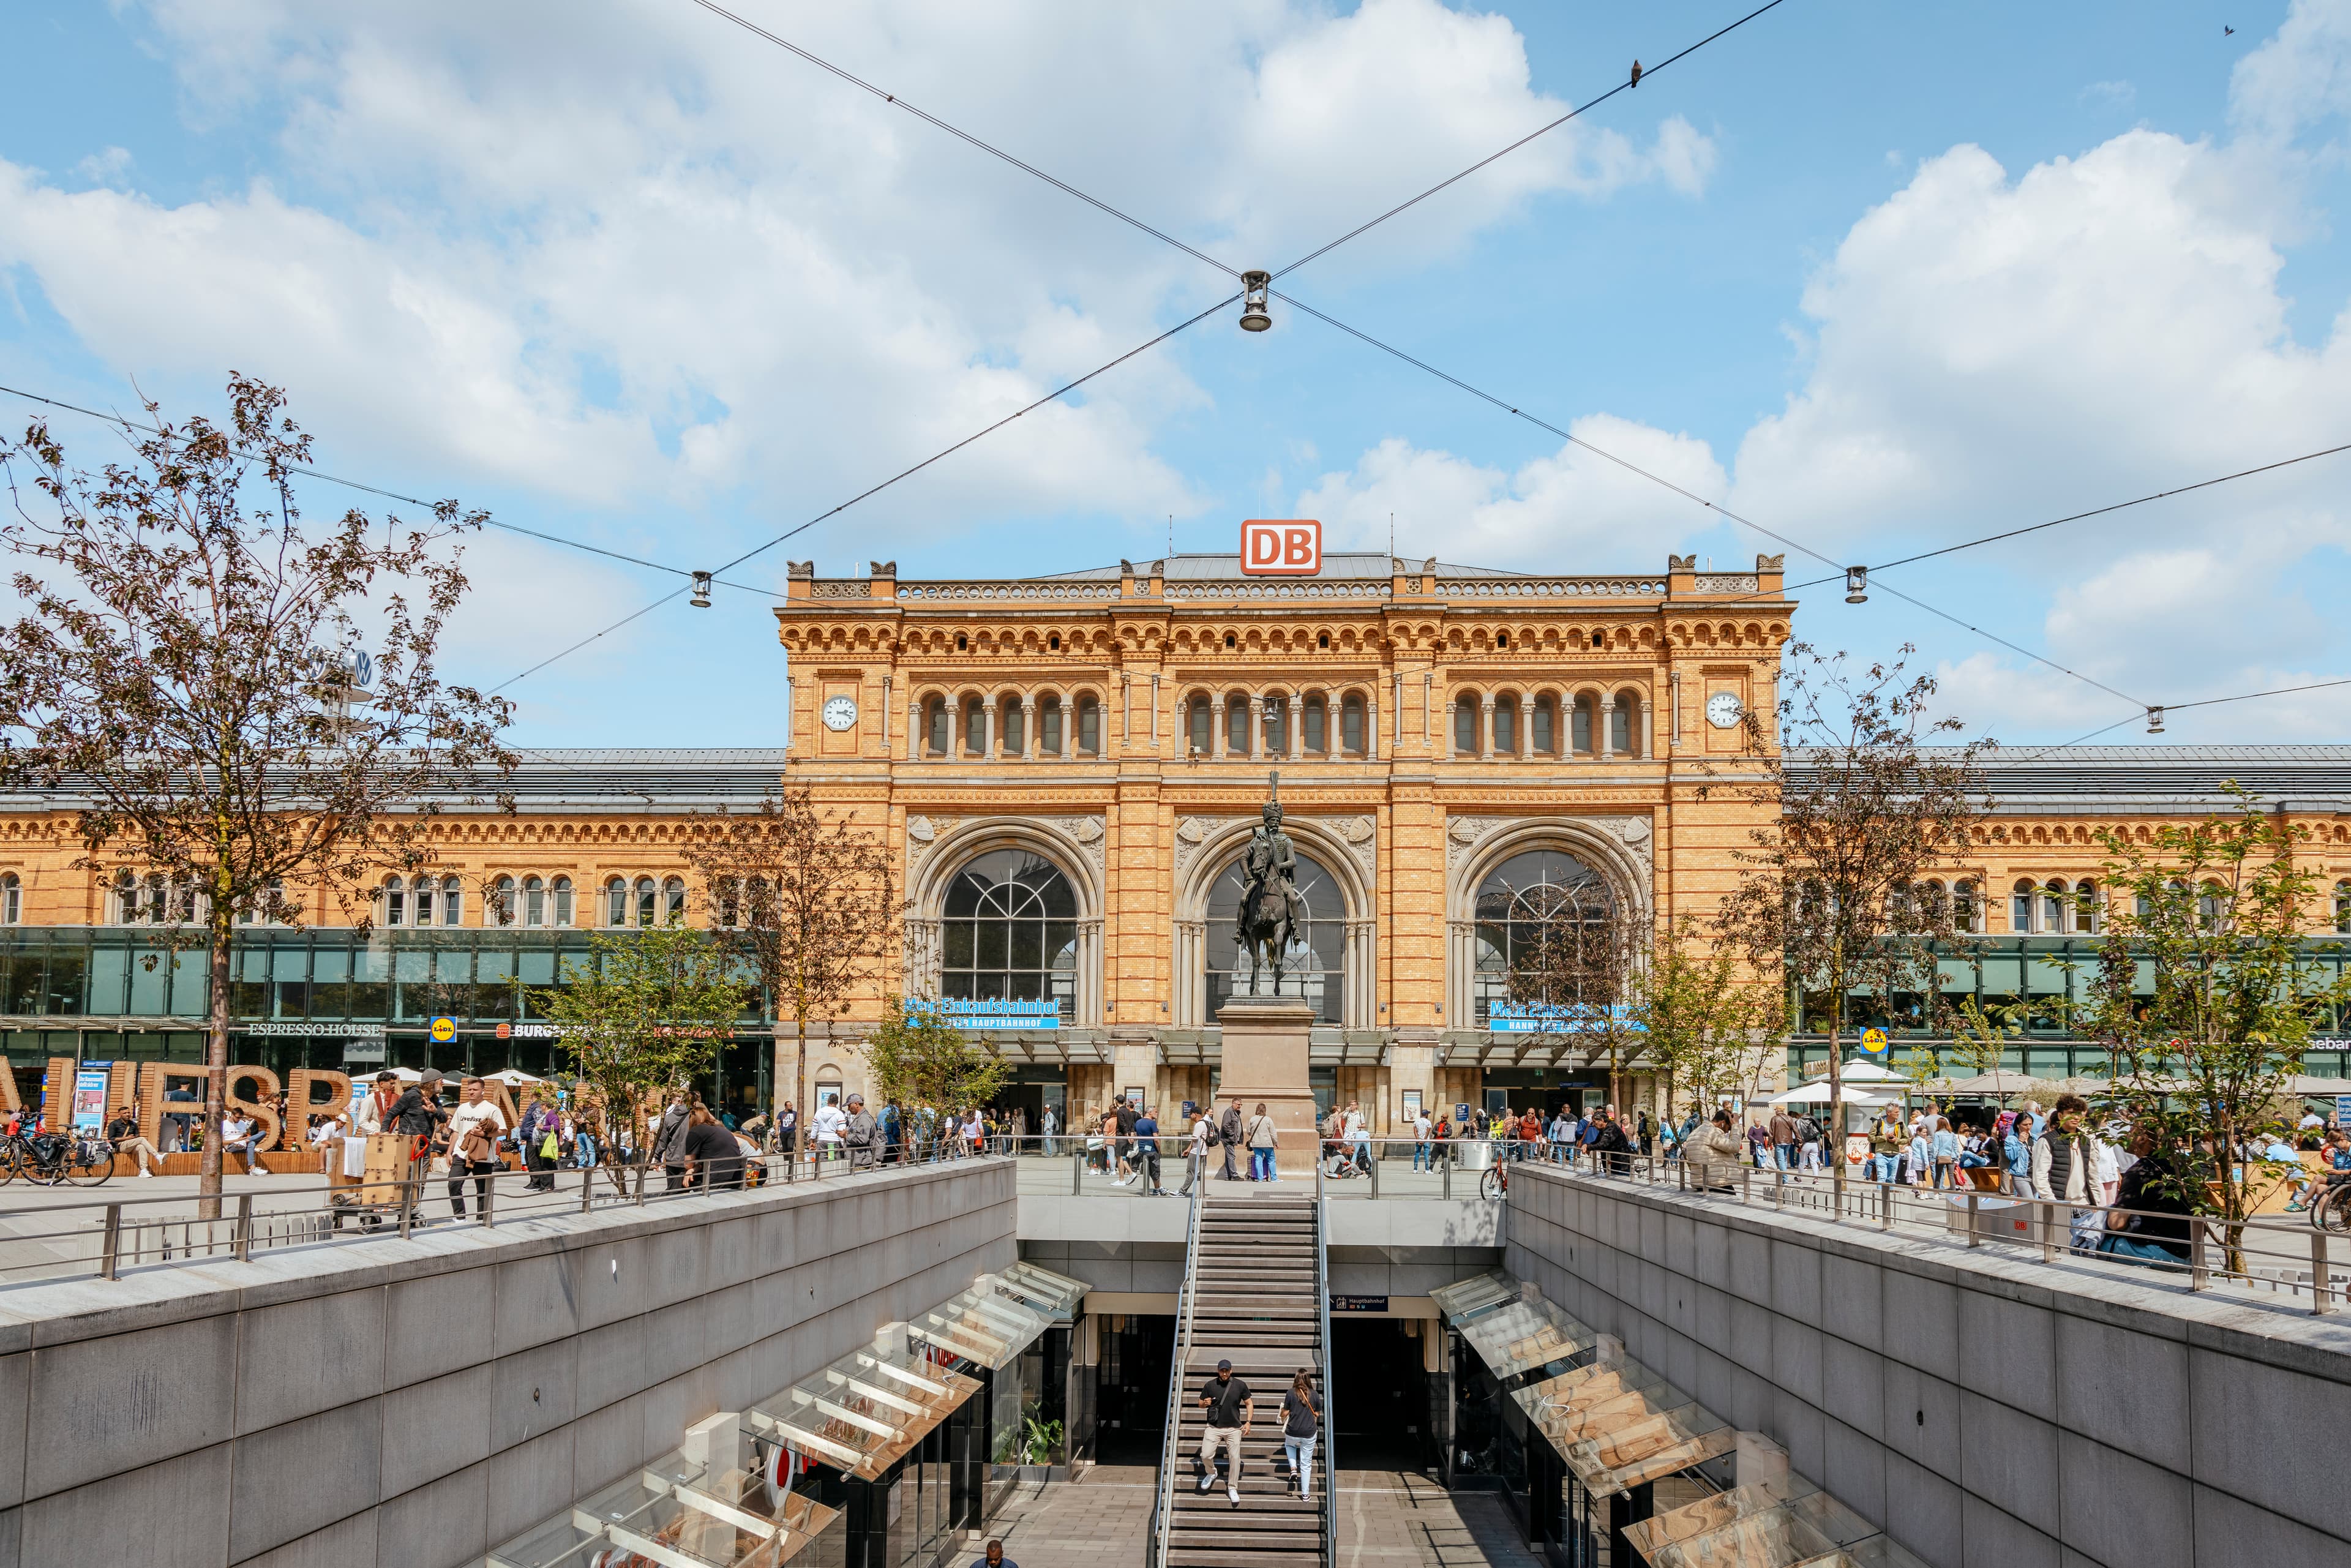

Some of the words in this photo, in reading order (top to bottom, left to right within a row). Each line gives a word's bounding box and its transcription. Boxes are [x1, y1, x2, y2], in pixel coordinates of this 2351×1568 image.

[1251, 528, 1313, 565] DB
[942, 997, 1060, 1015] Einkaufsbahnhof
[1490, 1000, 1526, 1018] Mein
[249, 1023, 325, 1036] ESPRESSO
[326, 1024, 381, 1036] HOUSE
[972, 1019, 1041, 1027] HAUPTBAHNHOF
[1804, 1059, 1831, 1075] COLOSSEU
[1859, 1141, 1869, 1149] Caf
